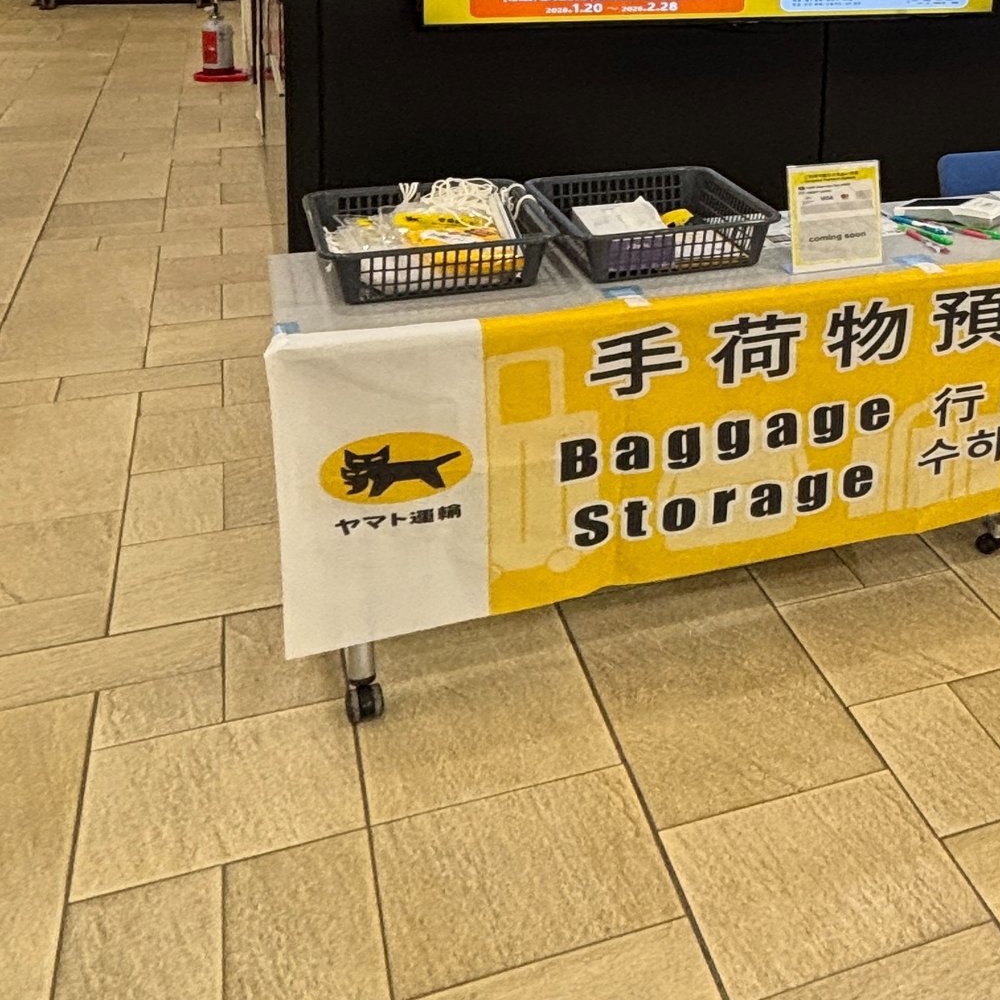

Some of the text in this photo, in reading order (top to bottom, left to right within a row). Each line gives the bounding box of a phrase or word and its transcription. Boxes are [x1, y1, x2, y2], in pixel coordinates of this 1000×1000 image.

[808, 231, 867, 243] coming soon
[560, 395, 891, 482] Baggage
[334, 502, 462, 536] ヤマト運輸
[573, 464, 874, 548] Storage
